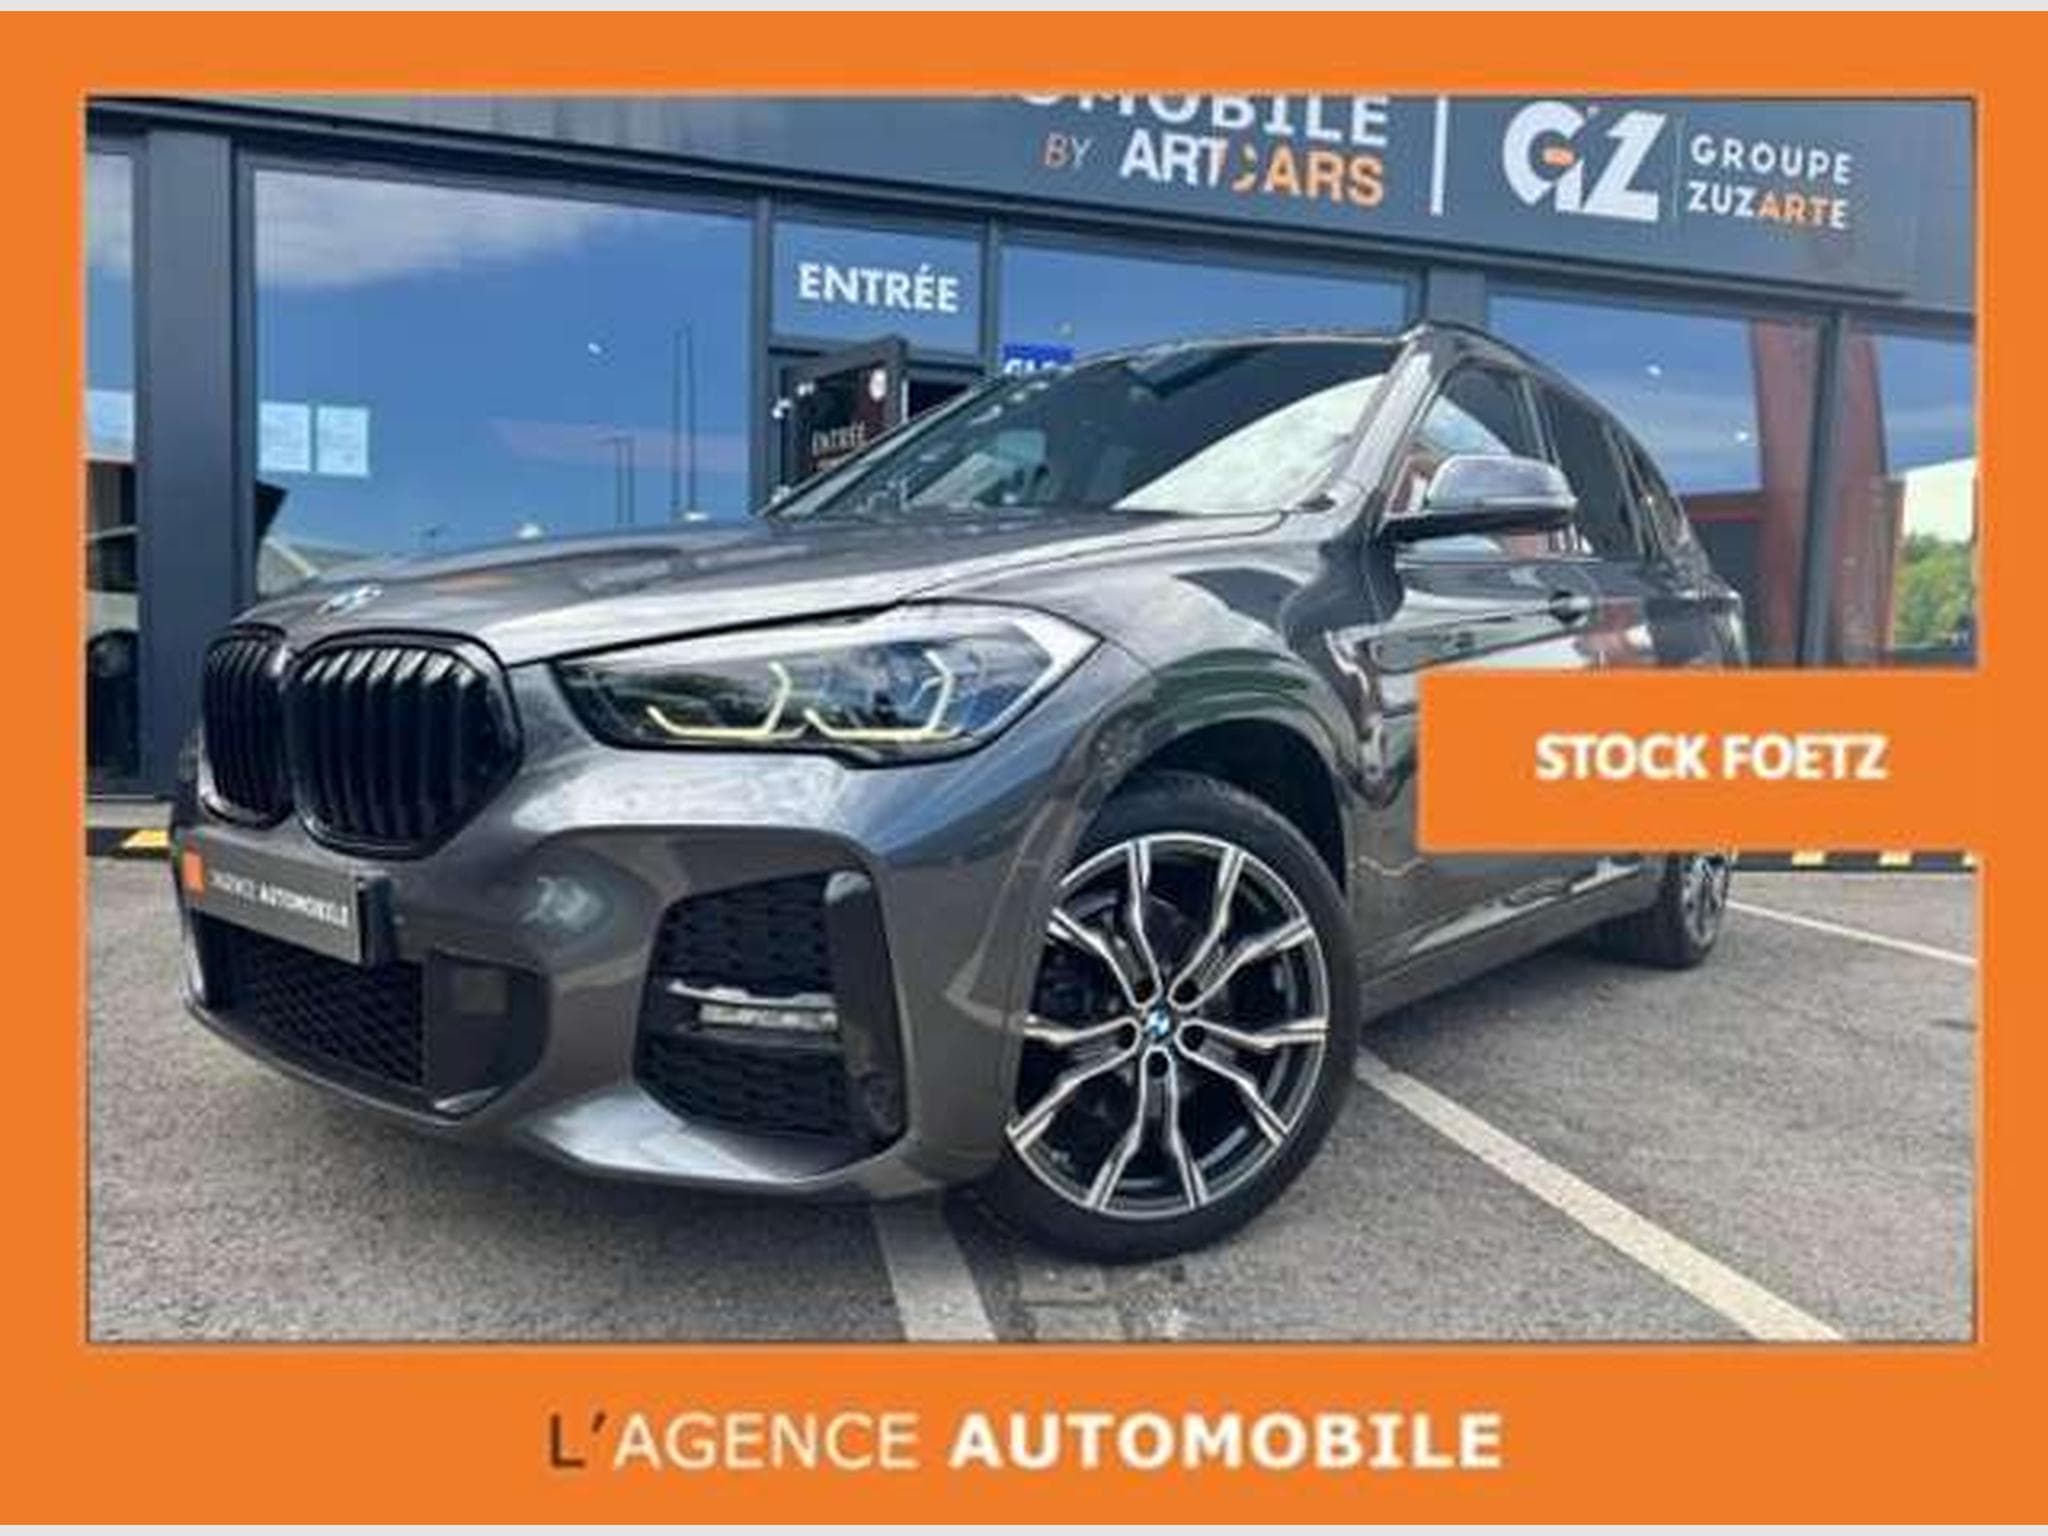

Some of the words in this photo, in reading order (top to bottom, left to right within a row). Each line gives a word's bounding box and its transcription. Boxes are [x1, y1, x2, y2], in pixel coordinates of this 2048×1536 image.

[1044, 132, 1092, 170] BY
[1690, 134, 1852, 185] GROUPE
[1687, 181, 1850, 230] ZUZARTE
[798, 262, 958, 313] ENTRÉE
